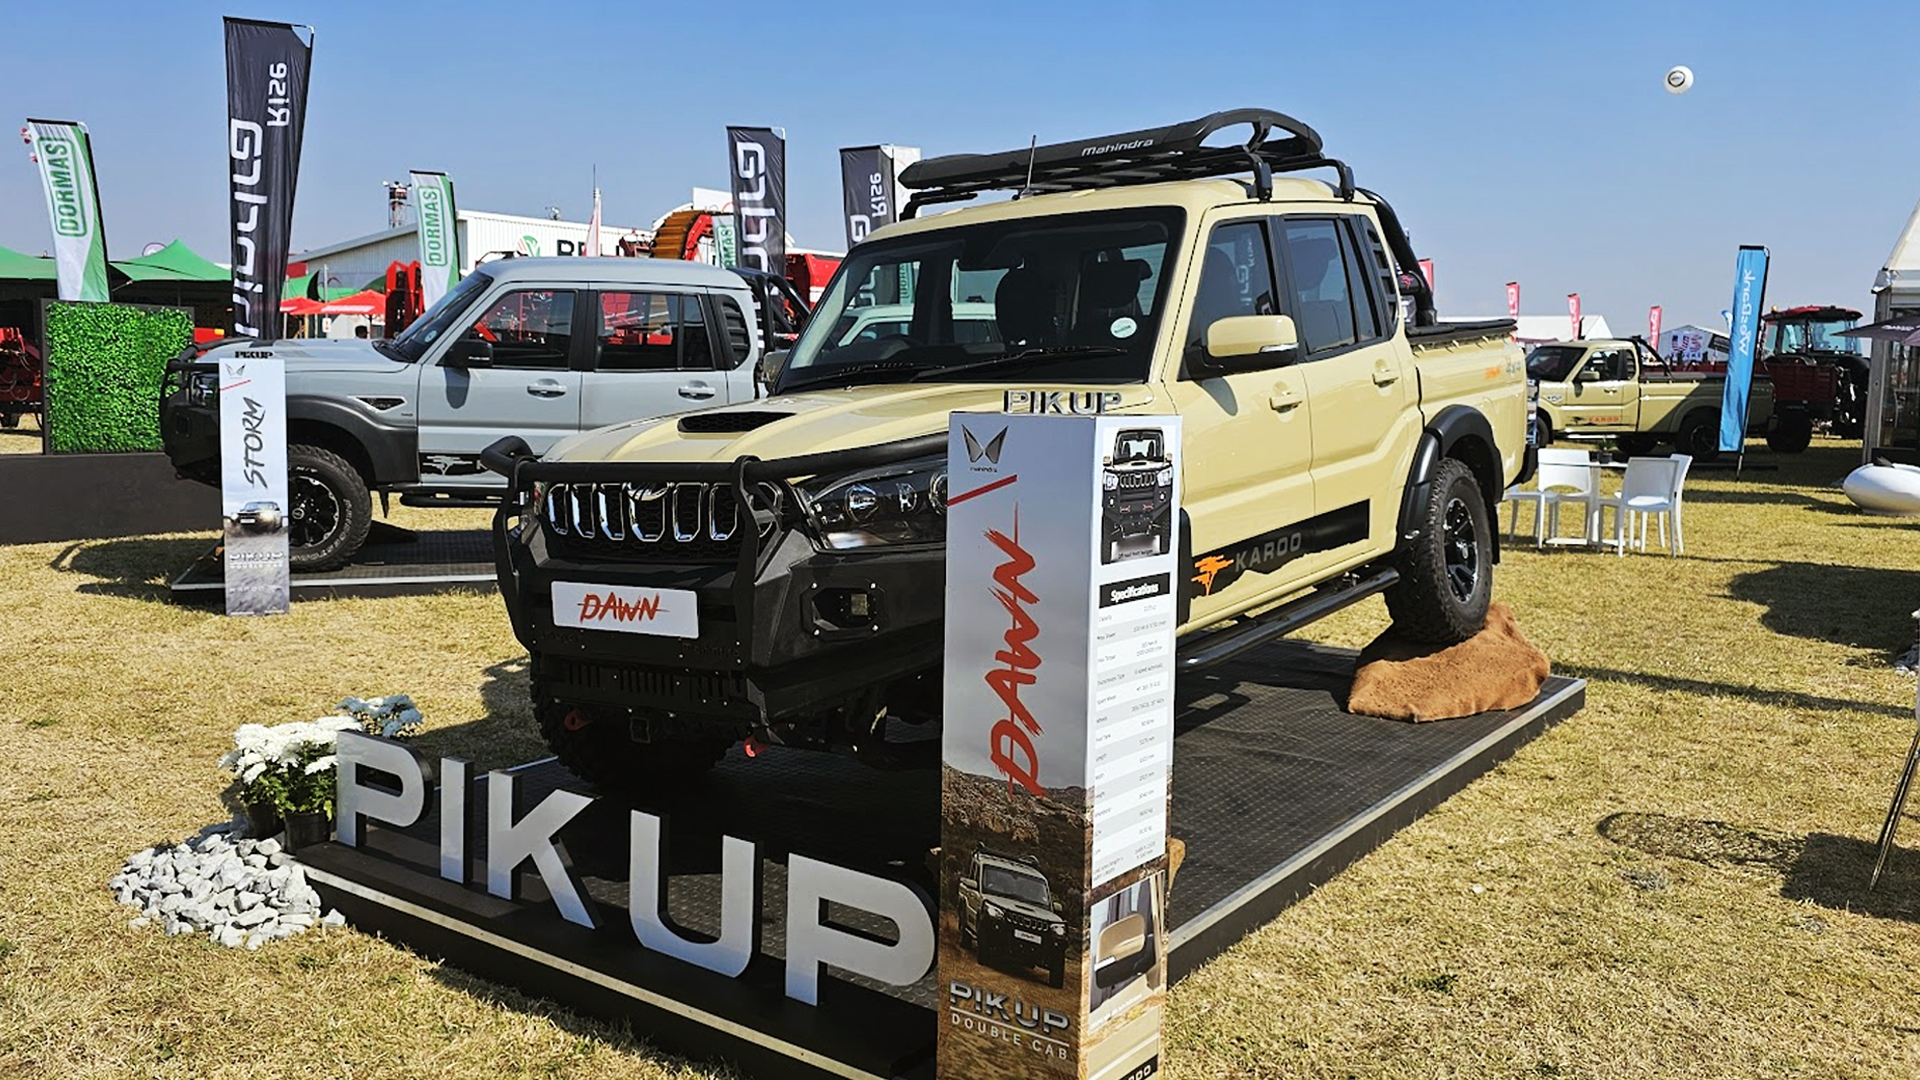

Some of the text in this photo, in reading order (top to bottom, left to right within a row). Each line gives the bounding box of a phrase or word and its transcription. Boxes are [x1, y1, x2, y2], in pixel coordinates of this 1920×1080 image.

[45, 143, 79, 231] DORMAS
[423, 190, 441, 262] DORMAS
[720, 229, 735, 268] RMAS
[1003, 390, 1122, 415] PIKUP
[242, 397, 268, 489] STORM
[1234, 532, 1303, 573] KAROO
[579, 591, 664, 624] DAWN
[1111, 583, 1159, 603] Specifications
[982, 526, 1046, 798] DAWN
[336, 729, 937, 1006] PIKUP
[950, 981, 1070, 1034] PIKUP
[952, 1013, 1067, 1060] DOUBLE CAB
